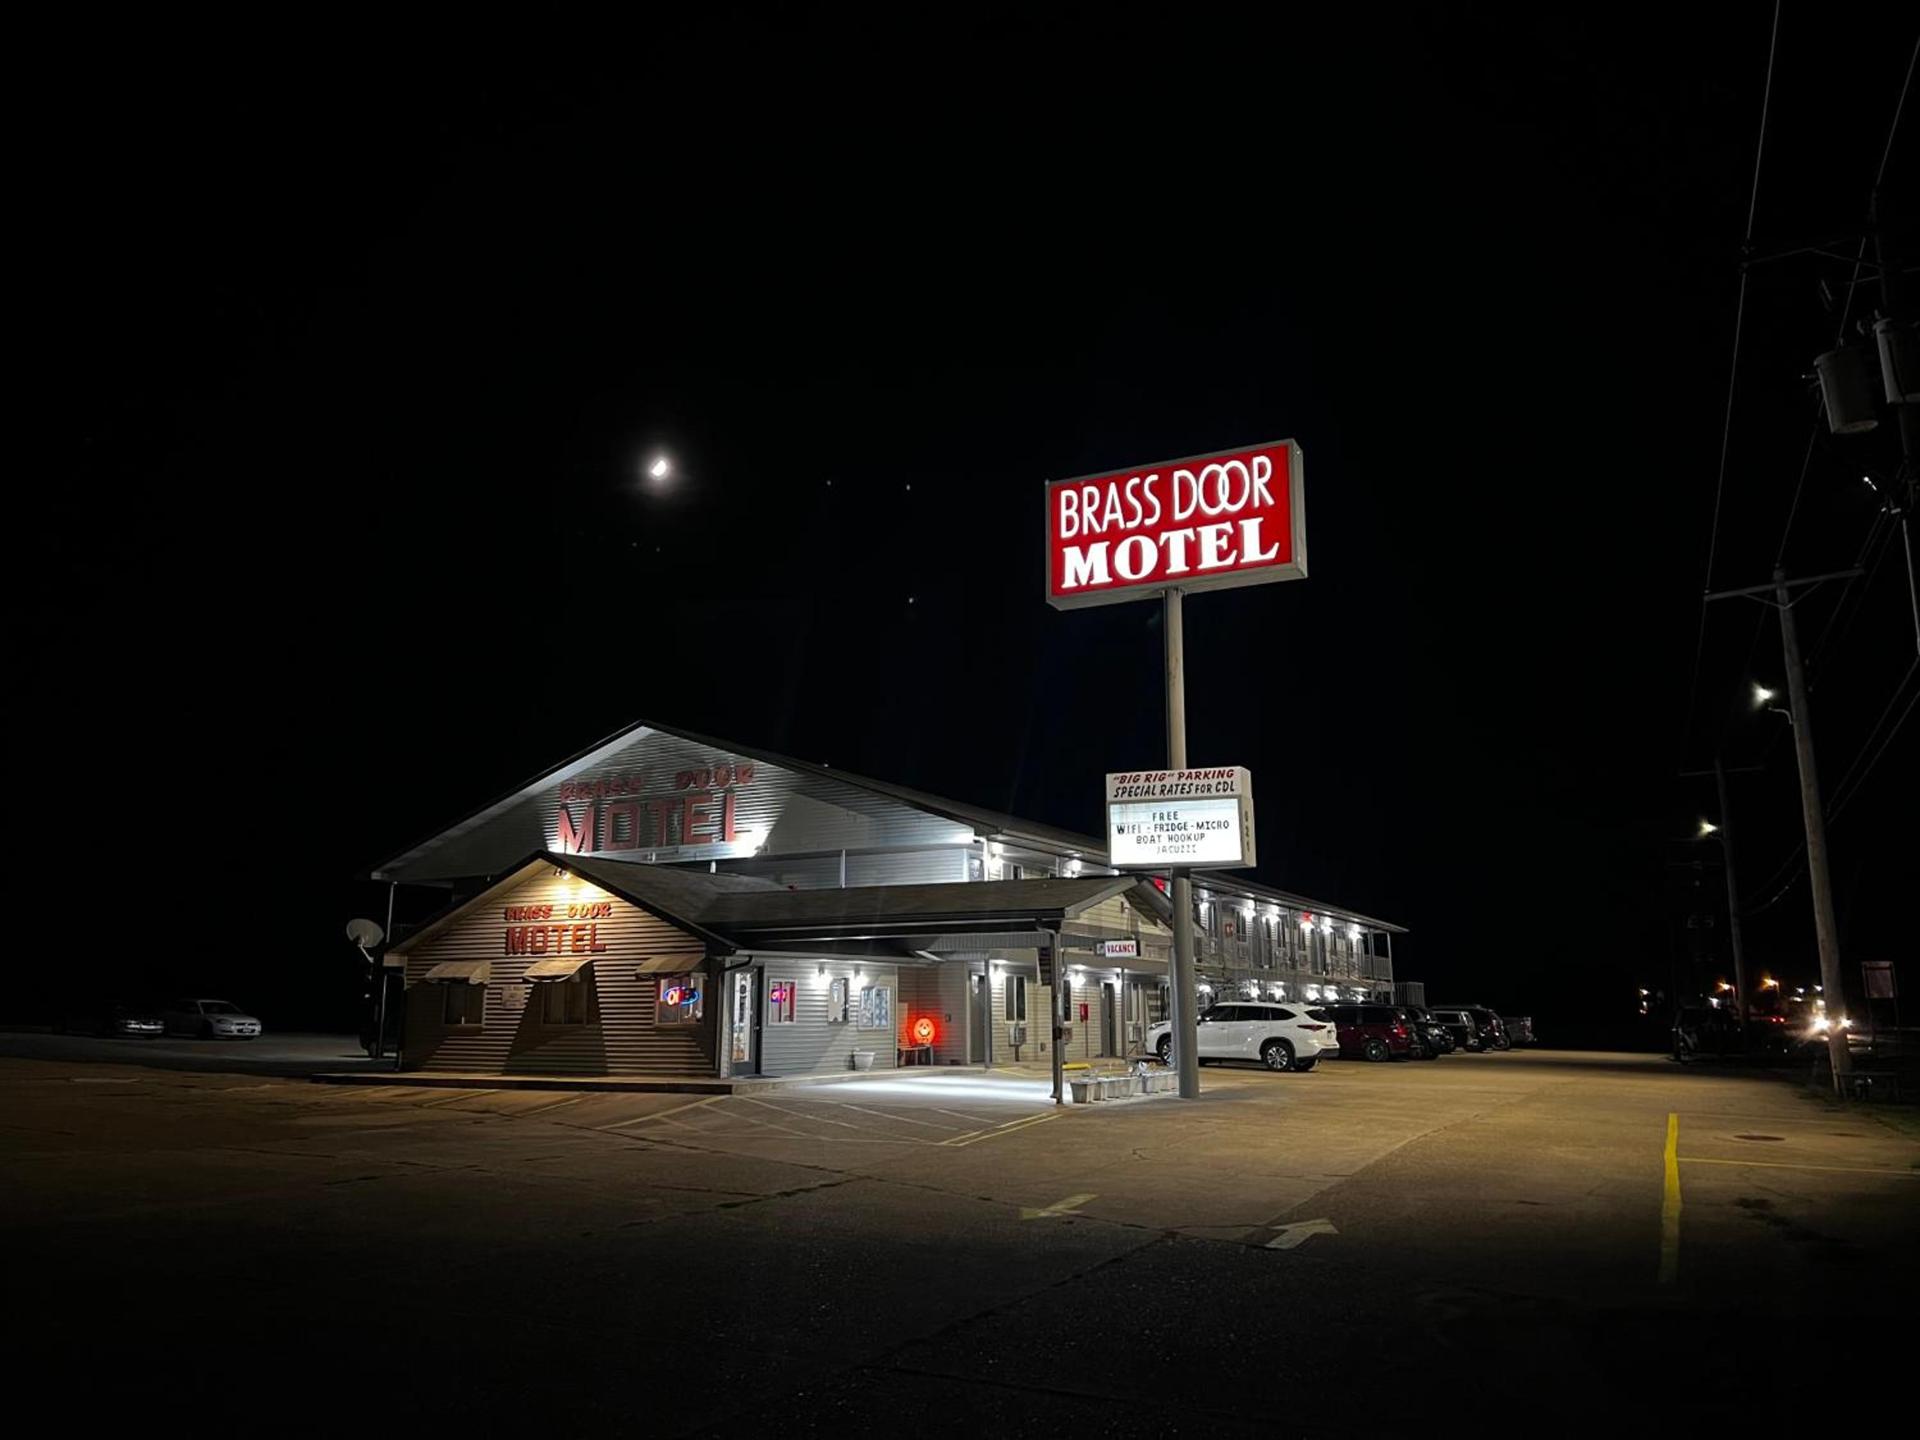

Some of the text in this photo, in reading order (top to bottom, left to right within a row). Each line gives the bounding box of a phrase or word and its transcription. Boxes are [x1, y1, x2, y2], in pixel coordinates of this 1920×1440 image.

[1061, 455, 1275, 538] BRASS DOOR
[1061, 517, 1280, 589] MOTEL
[1177, 769, 1235, 781] PARKING
[1113, 781, 1235, 798] SPECIAL RATES FOR CDL
[1152, 811, 1179, 822] FREE
[1116, 824, 1142, 835] WIFI
[1154, 822, 1188, 833] FRIDGE
[1196, 819, 1230, 830] MICRO
[1136, 833, 1206, 844] BOAT HOOKUP
[505, 923, 606, 955] MOTEL
[1106, 943, 1135, 953] VACANCY
